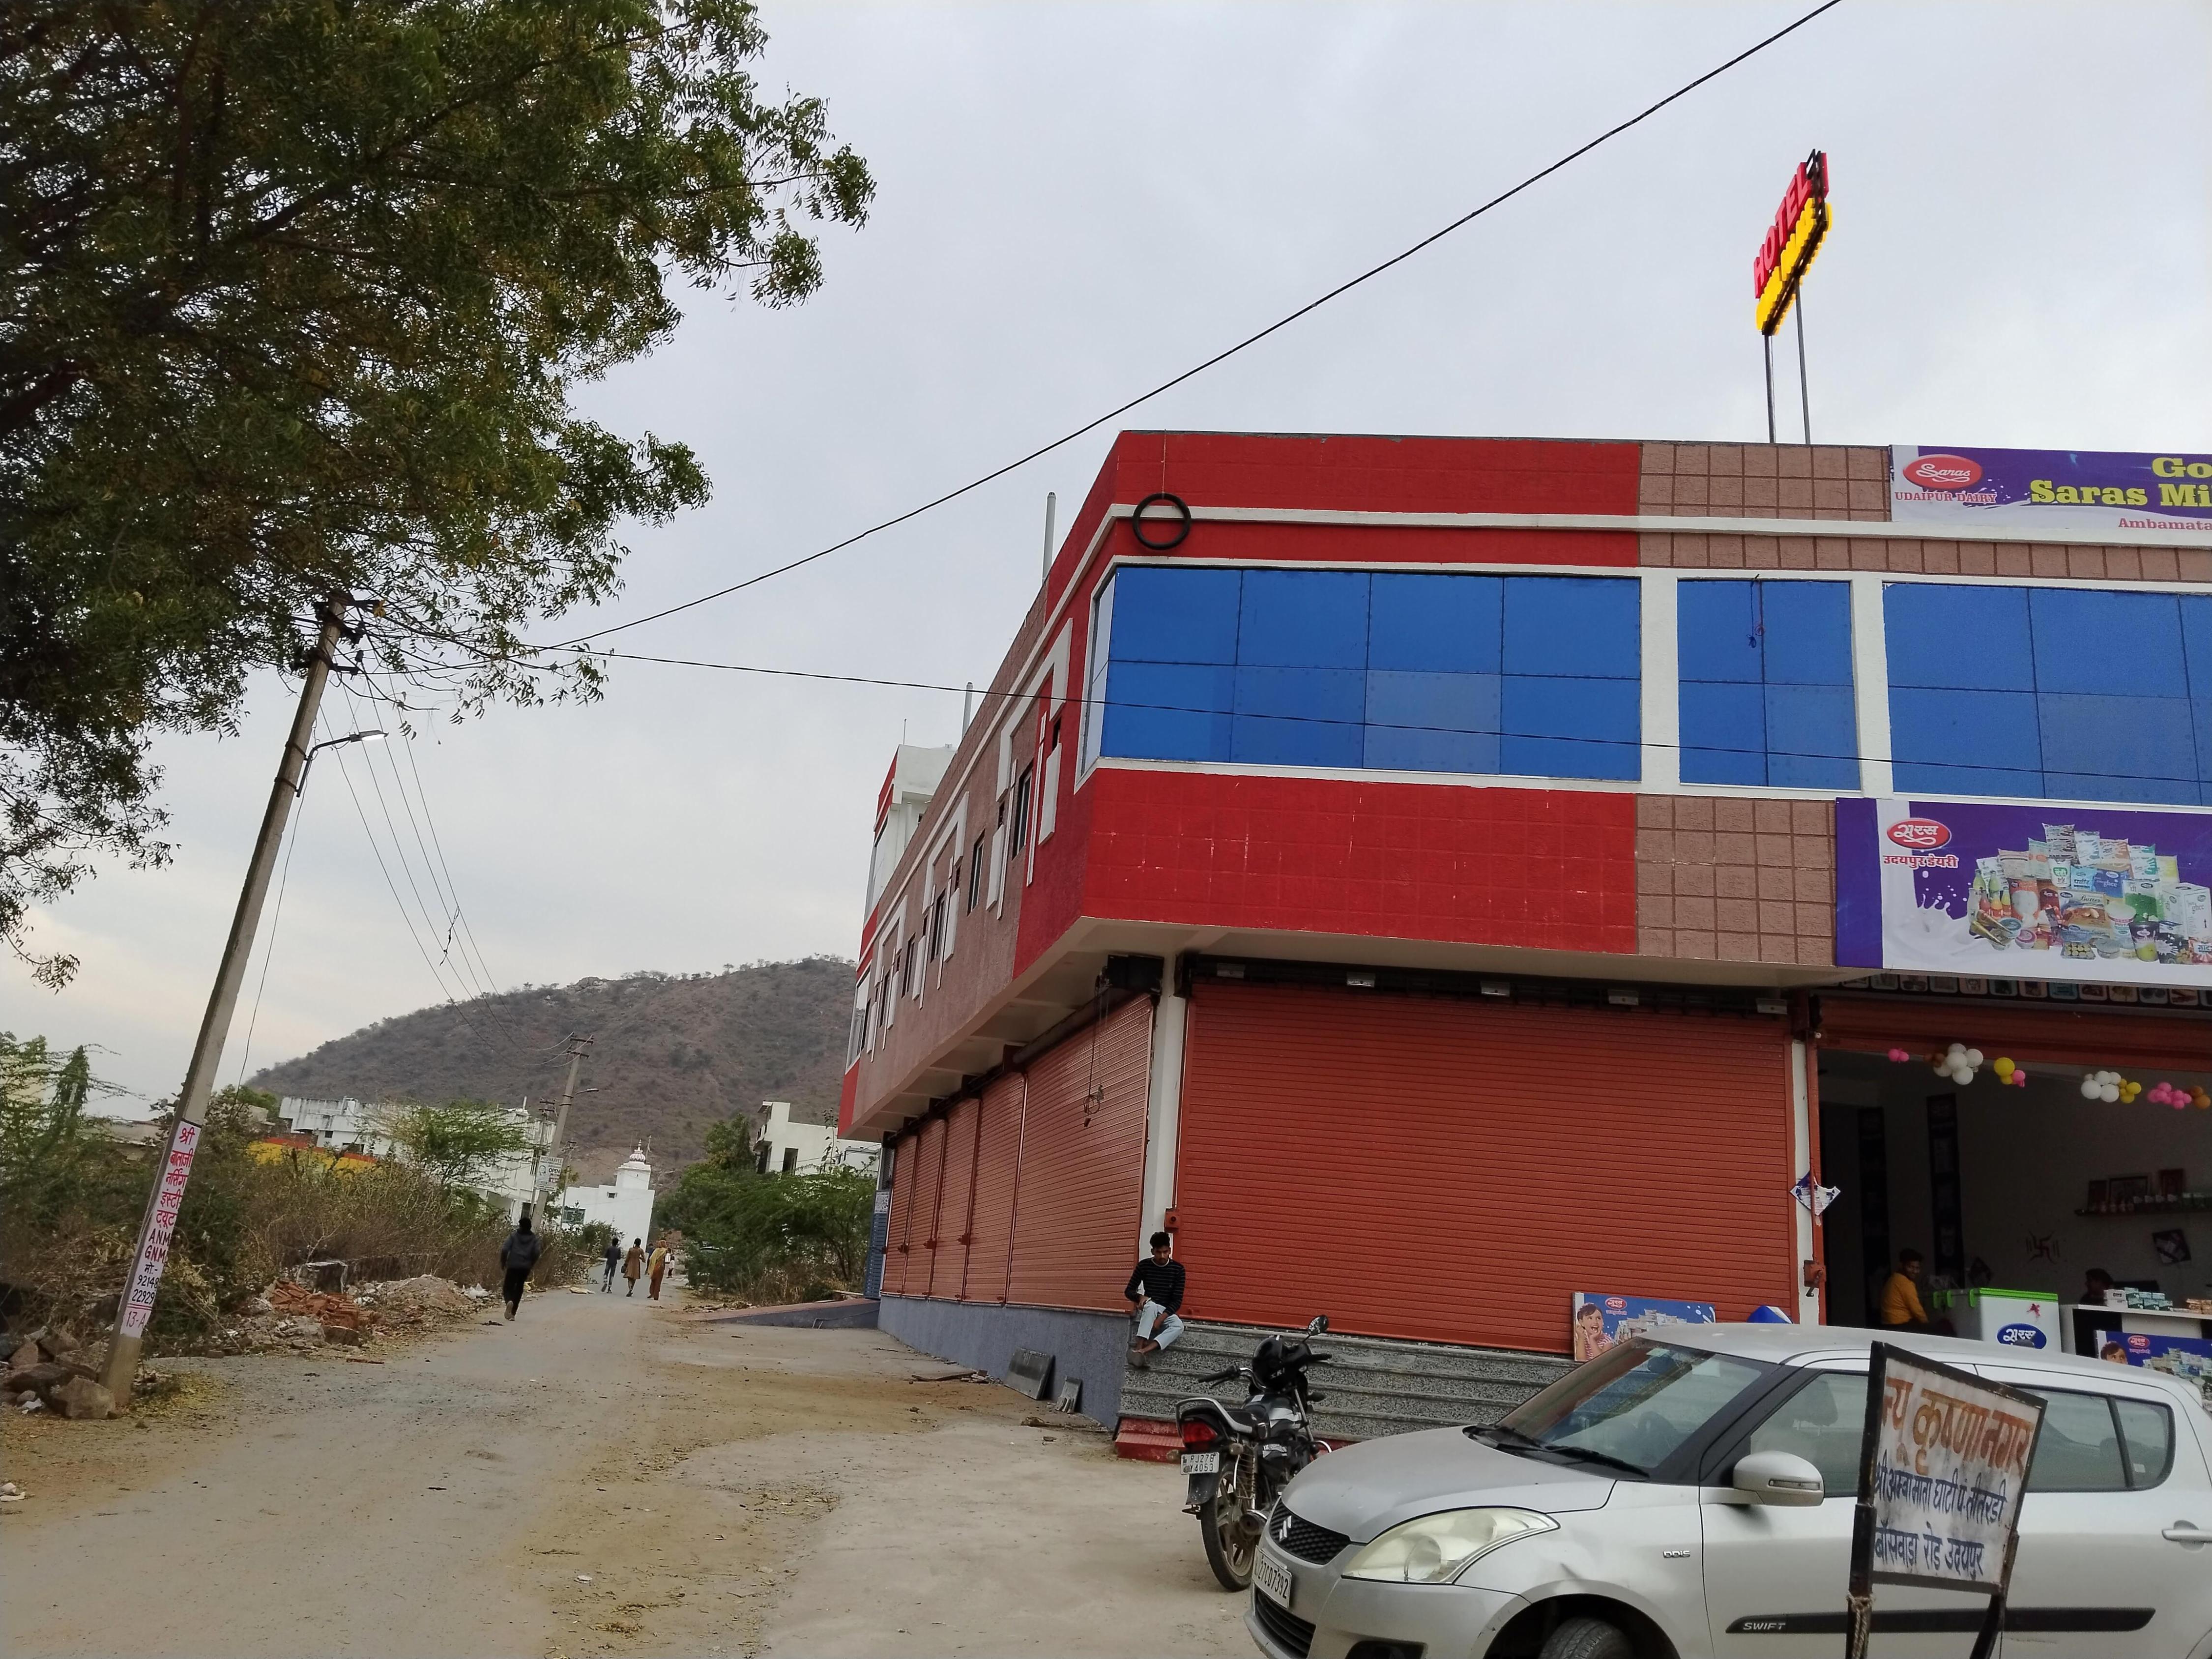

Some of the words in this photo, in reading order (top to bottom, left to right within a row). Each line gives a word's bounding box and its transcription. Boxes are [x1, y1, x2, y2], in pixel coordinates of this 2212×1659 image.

[1753, 162, 1813, 299] HOTEL
[1916, 463, 1971, 483] Saras
[1894, 492, 1954, 502] UDAIPUR
[1956, 492, 1997, 504] DAIRY
[2030, 479, 2148, 506] Saras
[2158, 483, 2212, 507] Mi
[2118, 518, 2212, 531] Ambamata
[1893, 824, 1939, 845] सरस
[1882, 855, 1925, 870] उदयपुर
[1926, 853, 1959, 868] डेयरी
[179, 1127, 195, 1145] श्री
[170, 1148, 194, 1168] बालाजी
[137, 1275, 159, 1289] 92148
[132, 1289, 155, 1305] 22929
[126, 1311, 146, 1328] 13-A
[1922, 1520, 1943, 1571] रोड
[1945, 1537, 1984, 1581] उदयपुर
